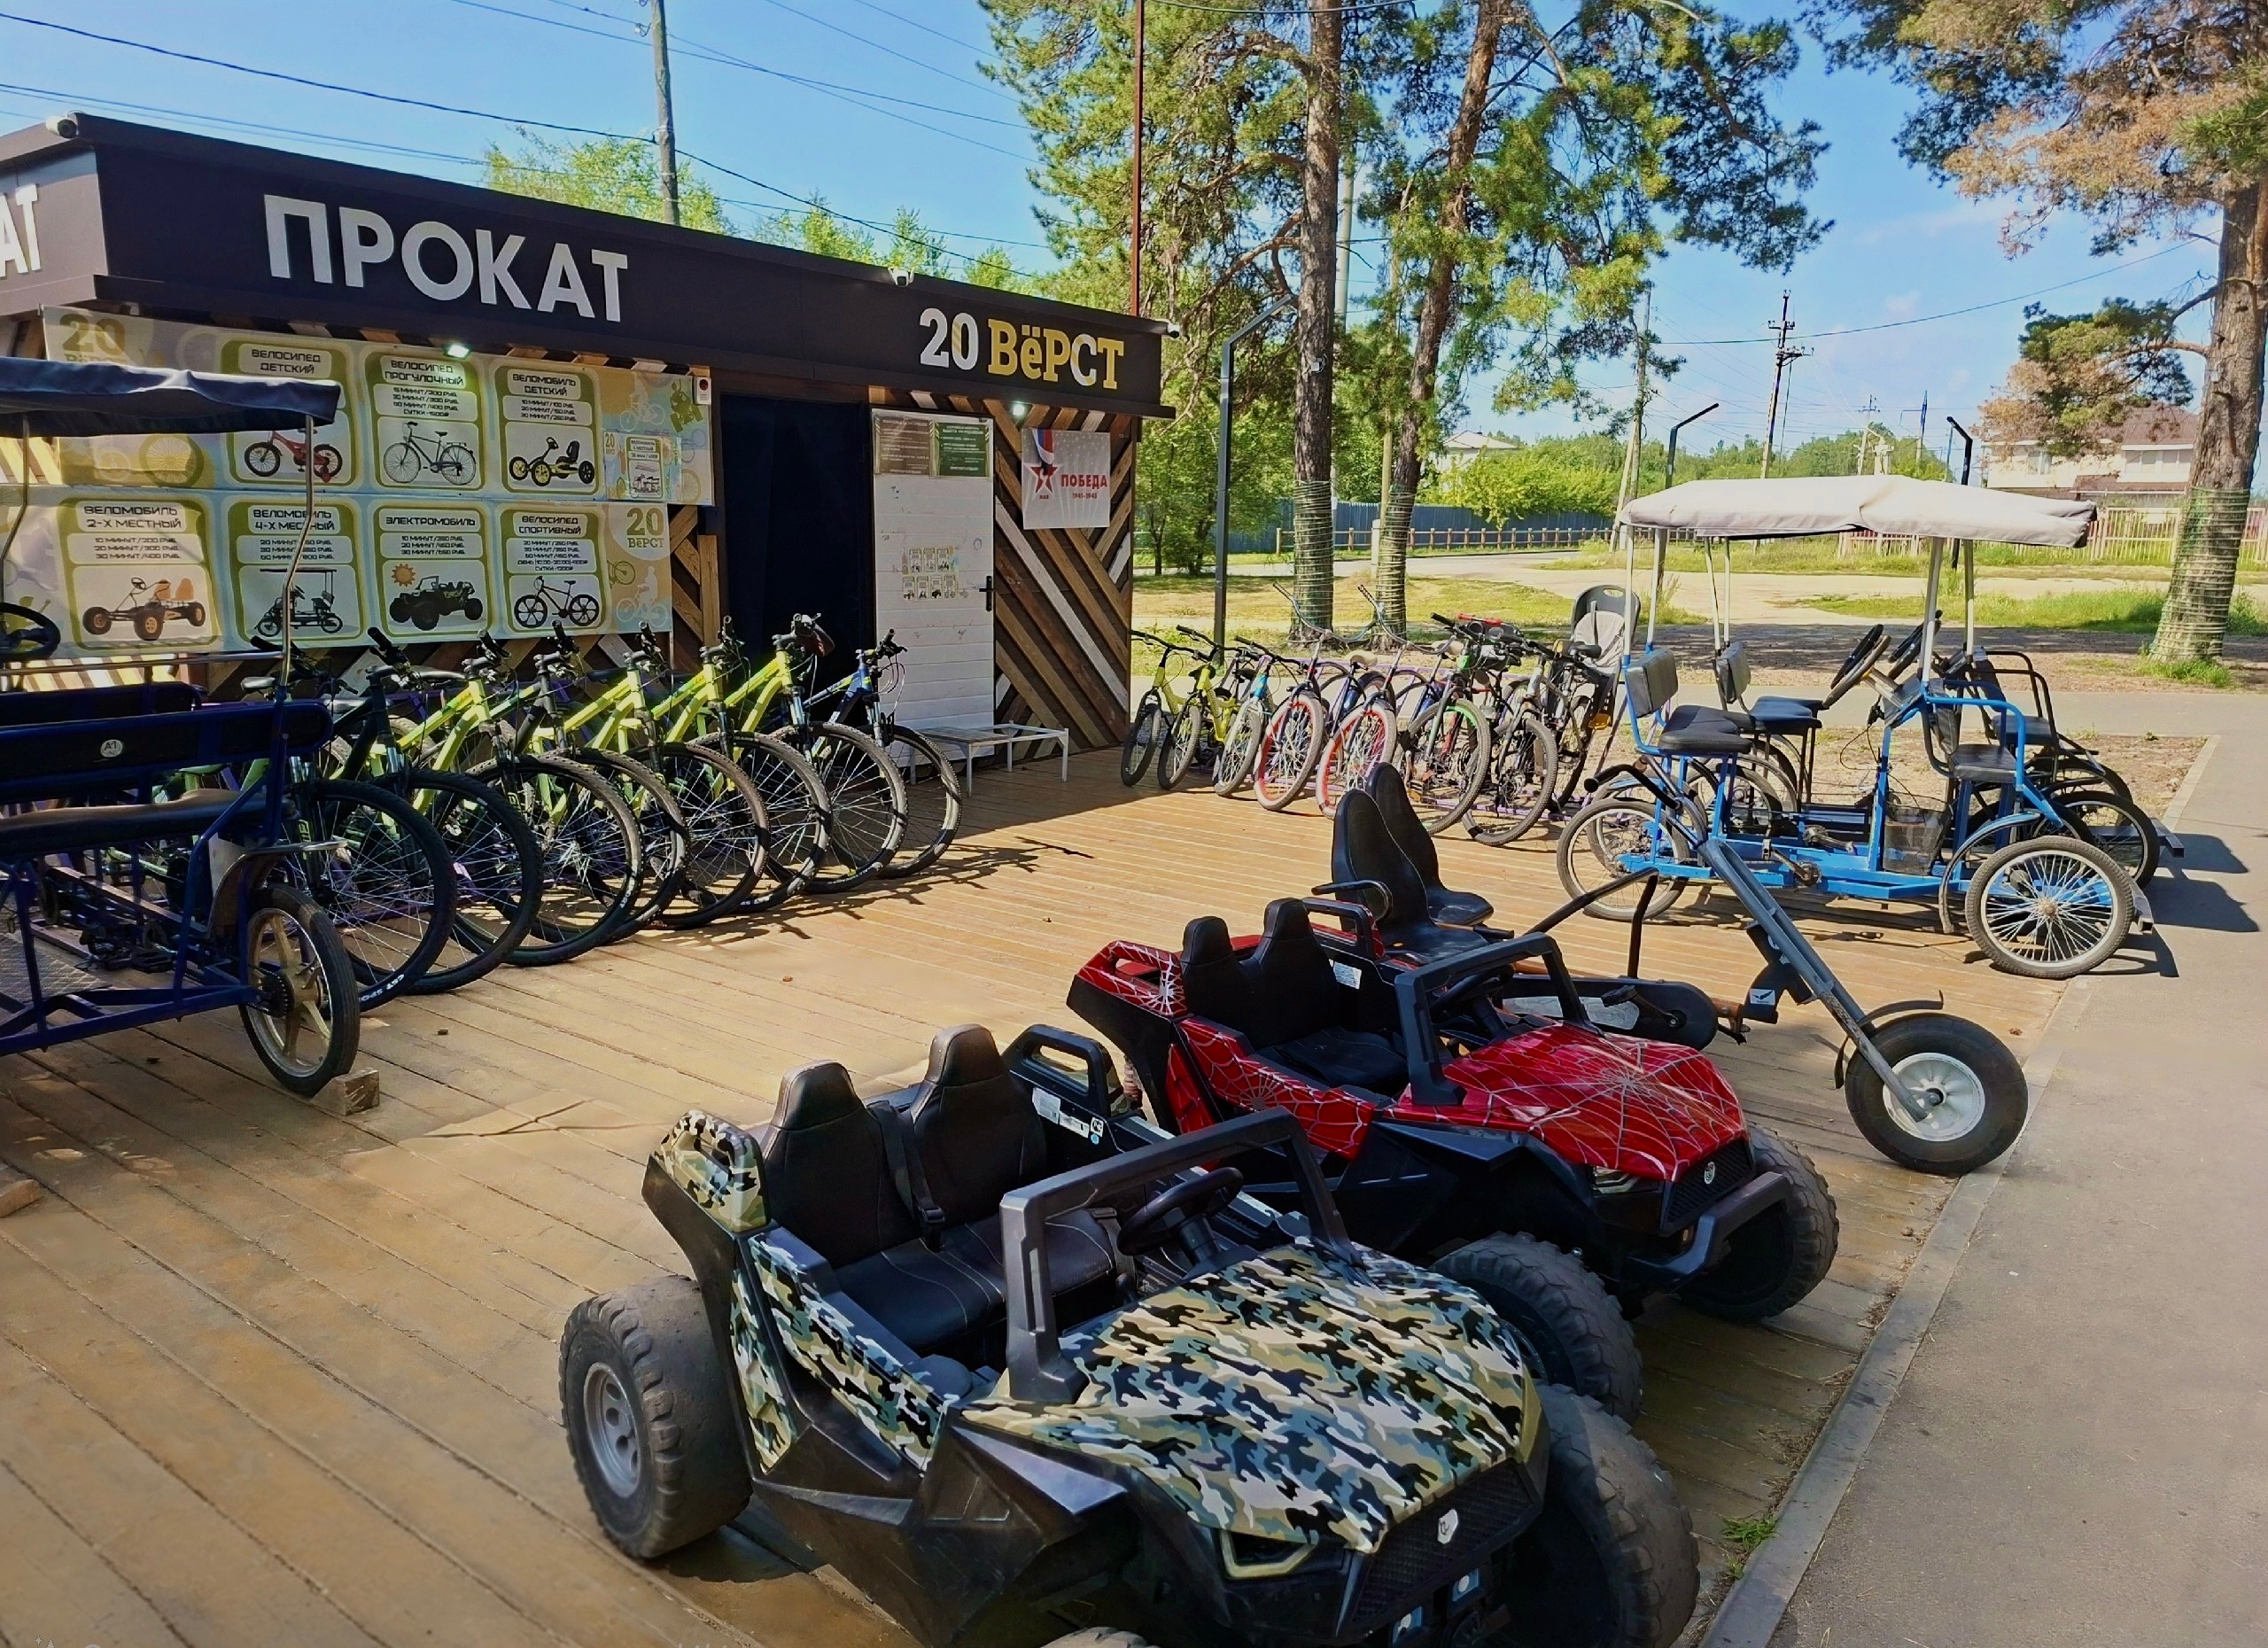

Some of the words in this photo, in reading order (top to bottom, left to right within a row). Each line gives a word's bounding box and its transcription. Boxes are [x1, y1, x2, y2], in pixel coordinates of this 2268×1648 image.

[264, 194, 627, 323] ПРОКАТ
[59, 313, 126, 355] 20
[919, 307, 979, 370] 20
[988, 318, 1124, 390] ВёРСТ
[251, 349, 322, 362] ВЕЛОСИПЕД
[260, 362, 315, 374] ДЕТСКИЙ
[391, 360, 454, 373] ВЕЛОСИПЕД
[384, 370, 463, 385] ПРОГУЛОЧНЫЙ
[512, 374, 576, 386] ВЕЛОМОБИЛЬ
[524, 385, 567, 396] ДЕТСКИЙ
[1060, 474, 1107, 489] ПОБЕДА
[84, 506, 177, 516] ВЕЛОМОБИЛЬ
[86, 519, 113, 528] 2-Х
[116, 518, 182, 528] МЕСТНЫЙ
[255, 521, 276, 530] 4-Х
[278, 521, 335, 531] МЕСНЫЙ
[385, 517, 476, 526] ЭЛЕКТРОМОБИЛЬ
[522, 516, 578, 525] ВЕЛОСИПЕД
[626, 507, 664, 536] 20
[518, 525, 581, 535] СПОРТИВНЫЙ
[626, 537, 664, 548] ВёРСТ
